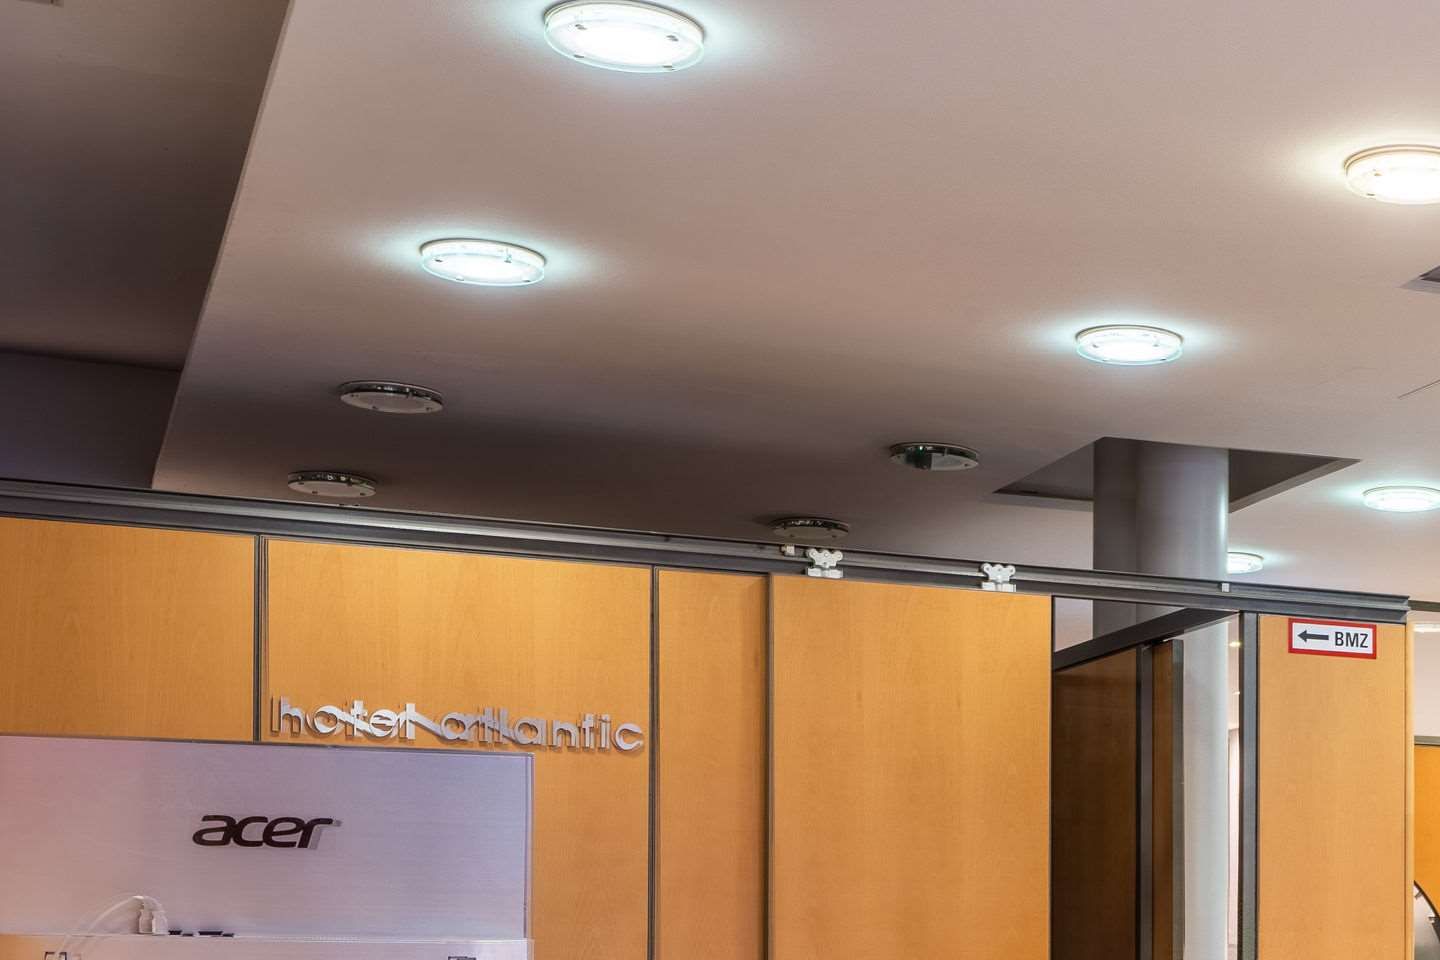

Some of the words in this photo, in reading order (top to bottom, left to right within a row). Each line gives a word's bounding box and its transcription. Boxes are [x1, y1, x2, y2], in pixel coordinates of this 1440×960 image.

[1334, 631, 1369, 649] BMZ
[272, 695, 416, 740] hotel
[440, 707, 644, 750] atlantic
[192, 815, 334, 849] acer
